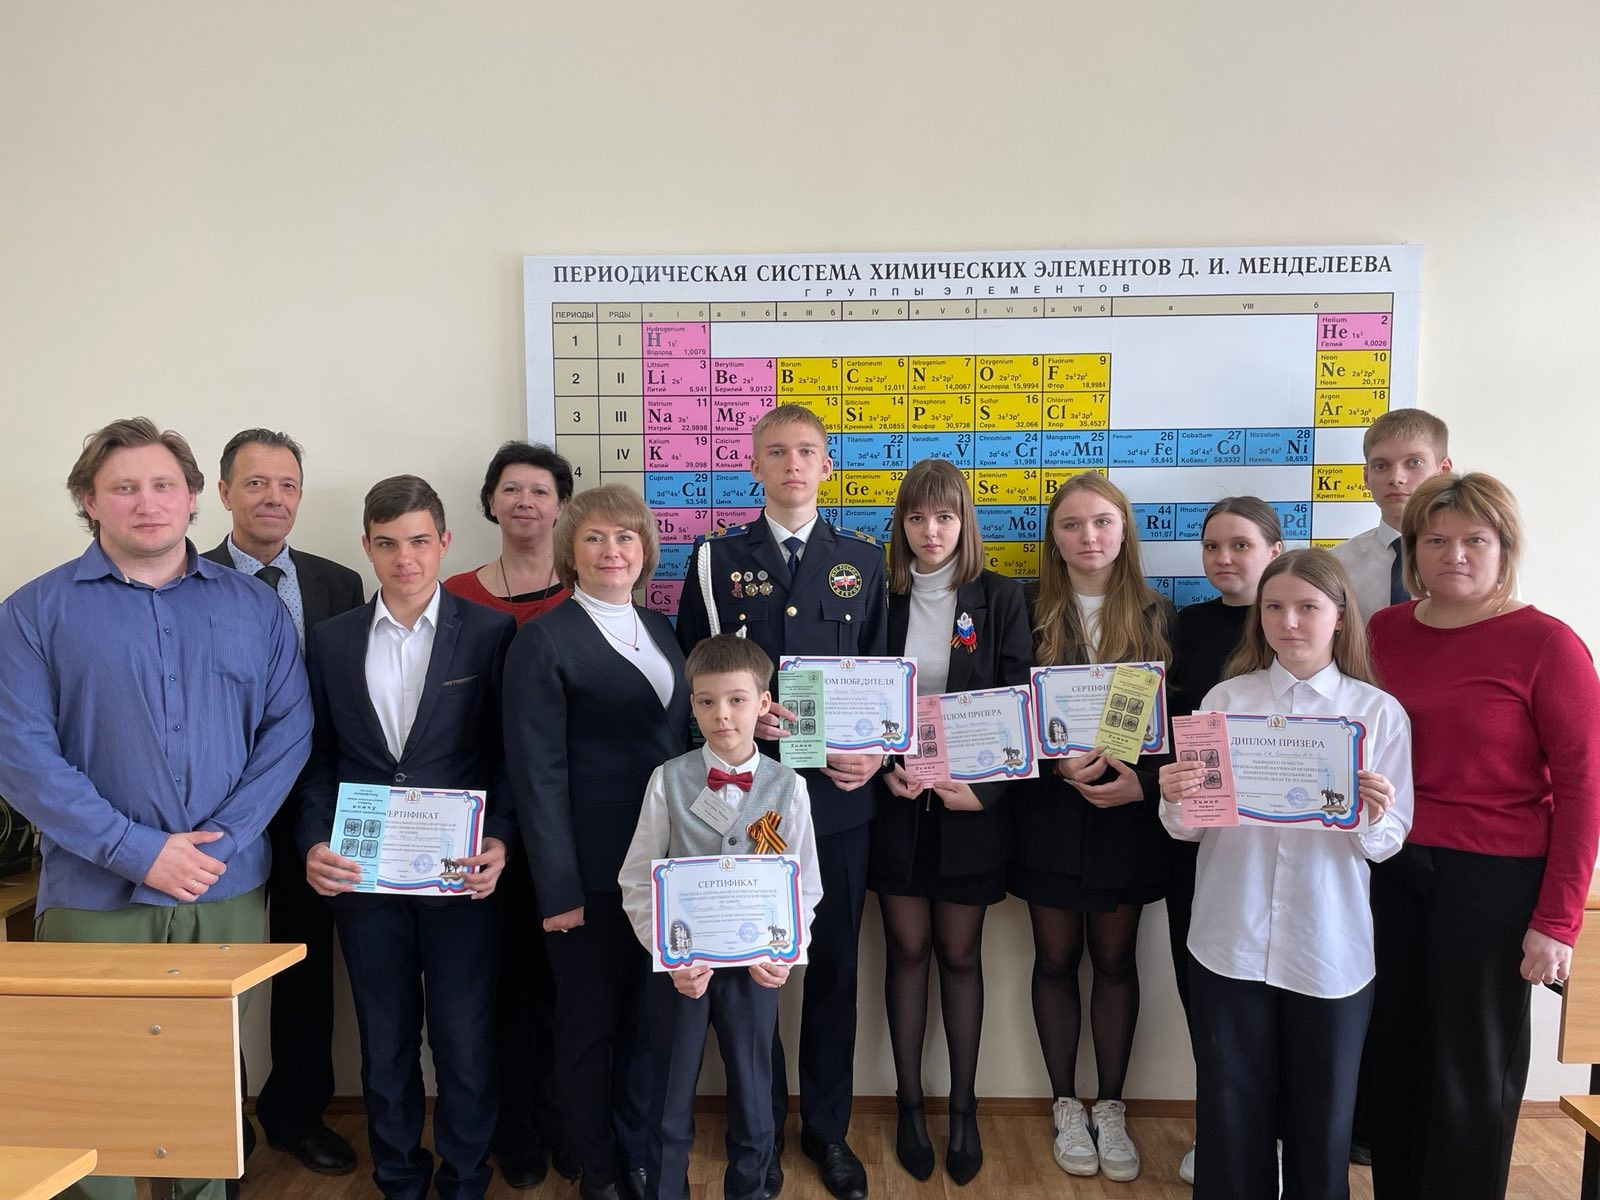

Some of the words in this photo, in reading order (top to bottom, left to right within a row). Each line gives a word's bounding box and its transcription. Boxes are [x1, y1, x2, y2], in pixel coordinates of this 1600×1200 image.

[553, 265, 747, 285] ПЕРИОДИЧЕСКАЯ
[756, 263, 862, 282] СИСТЕМА
[869, 261, 1027, 280] ХИМИЧЕСКИХ
[1034, 258, 1171, 278] ЭЛЕМЕНТОВ
[1178, 258, 1200, 279] Д.
[1207, 258, 1230, 275] И.
[1237, 255, 1393, 276] МЕНДЕЛЕЕВА
[555, 311, 594, 319] ПЕРИОДЫ
[608, 311, 631, 319] РЯДЫ
[1381, 316, 1388, 324] 2
[701, 325, 706, 334] 1
[1322, 324, 1348, 339] He
[572, 335, 578, 346] 1
[618, 334, 622, 346] I
[647, 333, 661, 347] H
[964, 358, 971, 367] 7
[1032, 357, 1039, 366] 8
[1100, 356, 1106, 365] 9
[1374, 352, 1387, 362] 10
[700, 360, 706, 369] 3
[766, 360, 773, 369] 4
[832, 360, 838, 368] 5
[898, 359, 904, 367] 6
[913, 368, 926, 382] N
[980, 367, 994, 381] O
[1048, 366, 1059, 380] F
[1321, 362, 1346, 377] Ne
[572, 373, 580, 384] 2
[617, 372, 625, 384] II
[648, 370, 666, 384] Li
[716, 370, 737, 384] Be
[782, 370, 794, 384] B
[847, 369, 859, 383] C
[959, 396, 971, 404] 15
[1026, 395, 1039, 404] 16
[1092, 394, 1105, 403] 17
[1372, 390, 1386, 400] 18
[697, 398, 707, 407] 11
[760, 398, 773, 407] 12
[825, 397, 838, 406] 13
[892, 397, 904, 406] 14
[846, 407, 863, 422] Si
[914, 407, 926, 421] P
[980, 406, 991, 420] S
[1047, 404, 1066, 419] Cl
[1320, 402, 1343, 416] Ar
[573, 411, 581, 422] 3
[615, 411, 627, 422] III
[648, 409, 672, 423] Na
[716, 408, 746, 426] Mg
[890, 435, 903, 444] 22
[958, 434, 971, 443] 23
[1025, 433, 1038, 442] 24
[1091, 432, 1104, 441] 25
[1161, 432, 1174, 440] 26
[1228, 431, 1241, 440] 27
[1296, 430, 1310, 439] 28
[695, 436, 707, 445] 19
[883, 444, 901, 458] Ti
[956, 444, 969, 458] V
[1015, 443, 1038, 457] Cr
[1072, 442, 1103, 456] Mn
[1154, 443, 1172, 455] Fe
[1217, 440, 1240, 454] Co
[1287, 440, 1308, 454] Ni
[616, 448, 630, 460] IV
[649, 446, 663, 460] K
[716, 446, 739, 460] Ca
[574, 467, 582, 478] 4
[695, 474, 708, 482] 29
[890, 472, 904, 481] 32
[1024, 471, 1037, 479] 34
[846, 482, 869, 496] Ge
[978, 480, 999, 494] Se
[1317, 476, 1341, 491] Kr
[682, 483, 706, 497] Cu
[825, 509, 838, 517] 39
[1023, 507, 1036, 516] 42
[1158, 506, 1171, 515] 44
[1294, 504, 1307, 512] 46
[695, 511, 708, 519] 37
[1008, 517, 1036, 530] Mo
[1146, 515, 1172, 529] Ru
[1282, 514, 1307, 528] Pd
[1023, 544, 1036, 552] 52
[1156, 579, 1169, 588] 76
[650, 591, 671, 605] Cs
[840, 678, 894, 686] ПОБЕДИТЕЛЯ
[1072, 684, 1112, 693] СЕРТИФИ
[968, 710, 1002, 719] ПРИЗЕРА
[1230, 736, 1276, 748] ДИПЛОМ
[1278, 738, 1325, 749] ПРИЗЕРА
[388, 810, 440, 820] ЕРТИФИКАТ
[698, 878, 759, 888] СЕРТИФИКАТ
